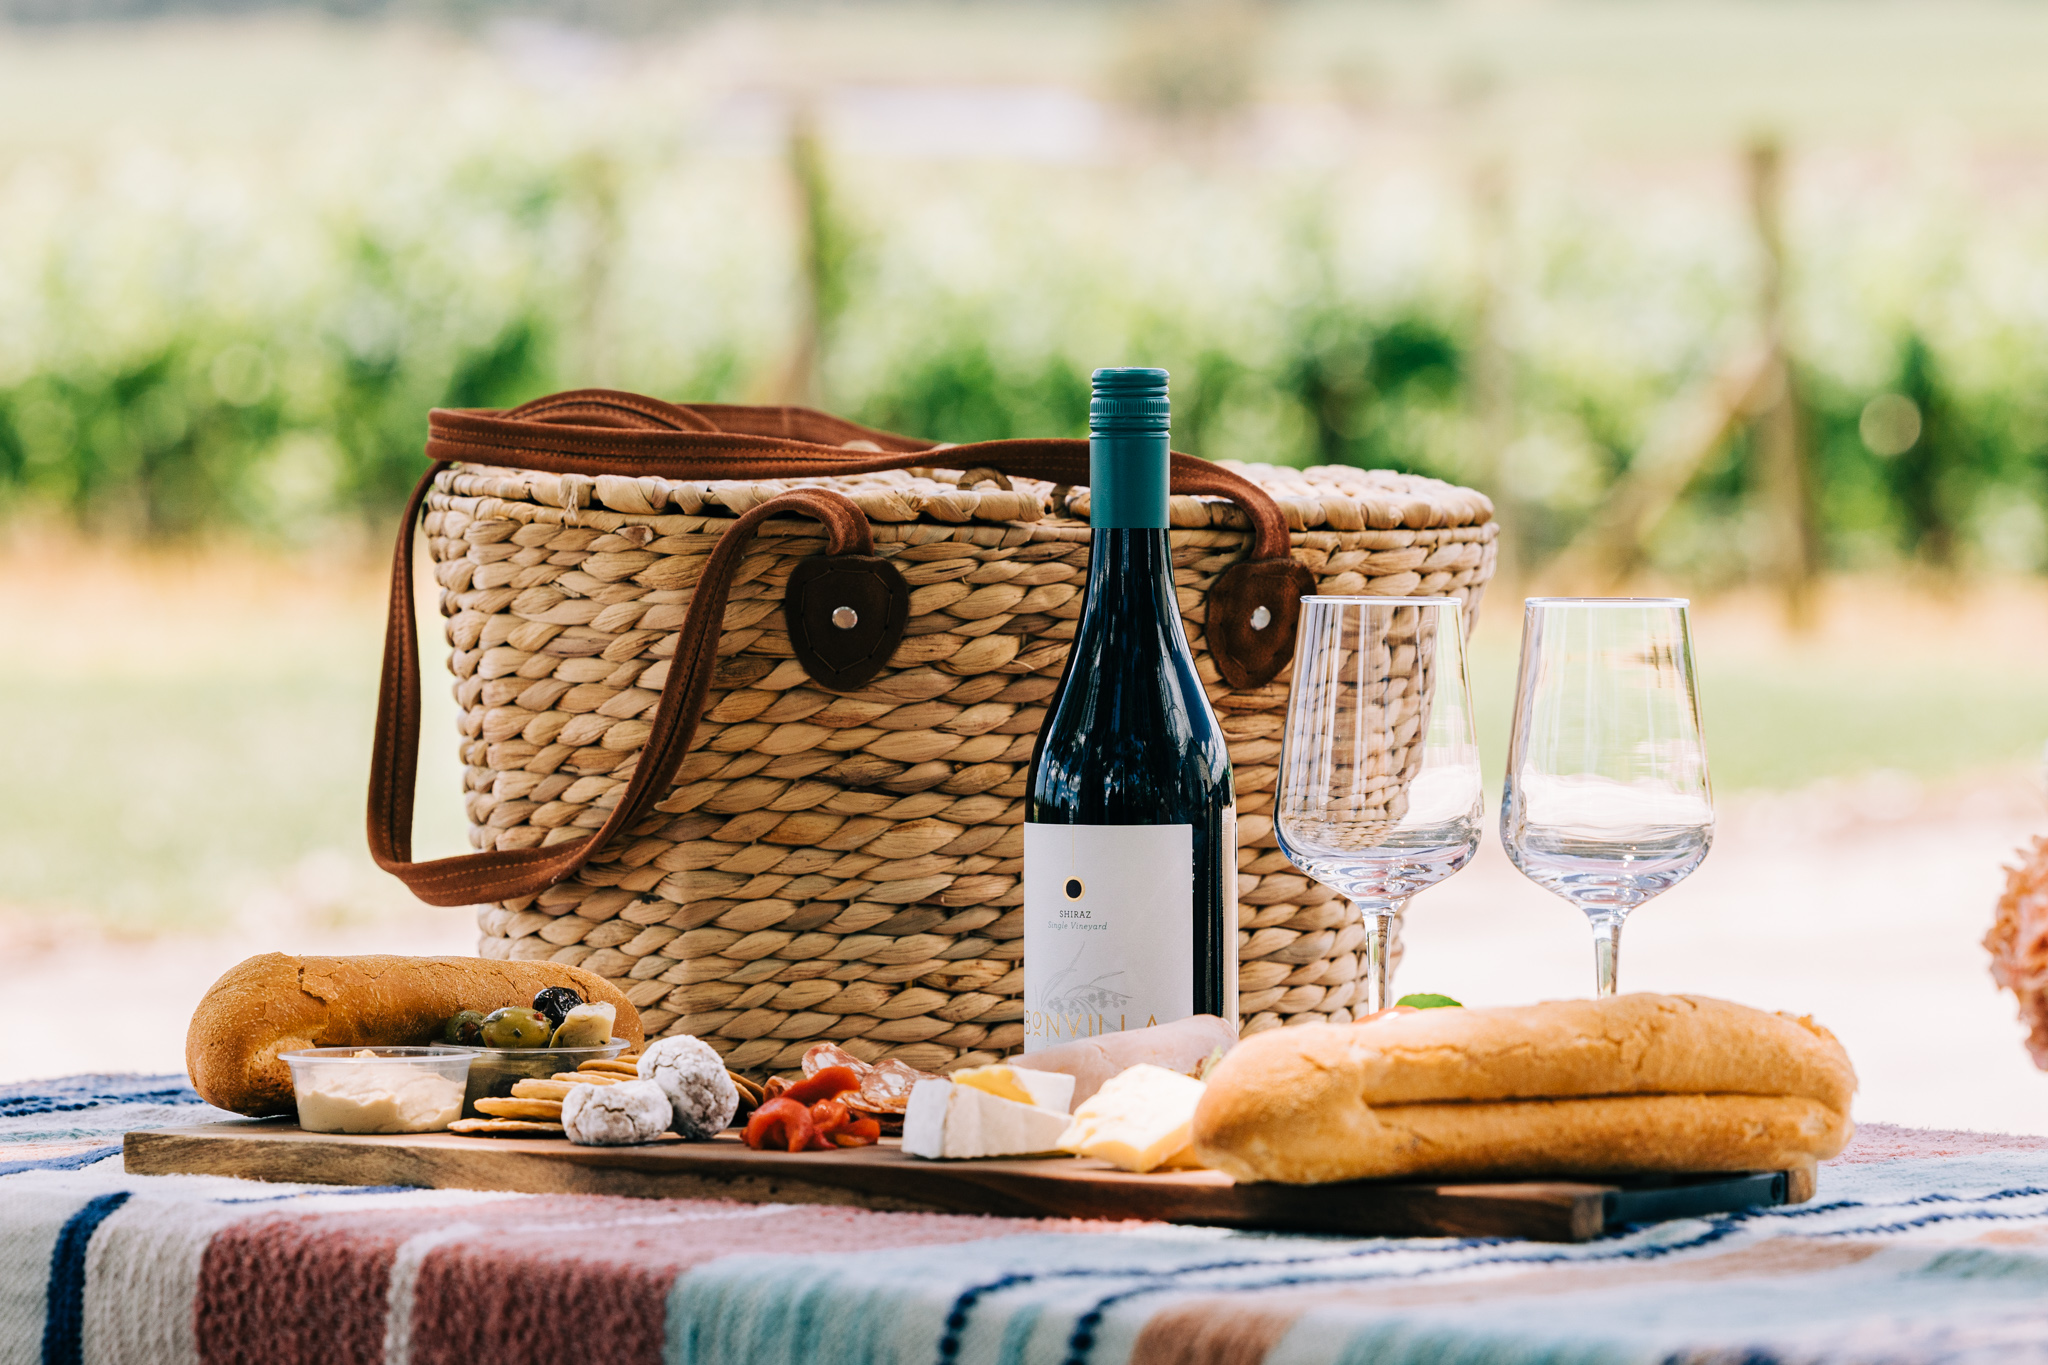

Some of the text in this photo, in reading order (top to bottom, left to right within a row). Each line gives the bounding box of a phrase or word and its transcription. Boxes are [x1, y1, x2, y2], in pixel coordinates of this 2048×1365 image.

[1059, 910, 1092, 919] SHIRAZ
[1047, 920, 1108, 932] Single Vineyard
